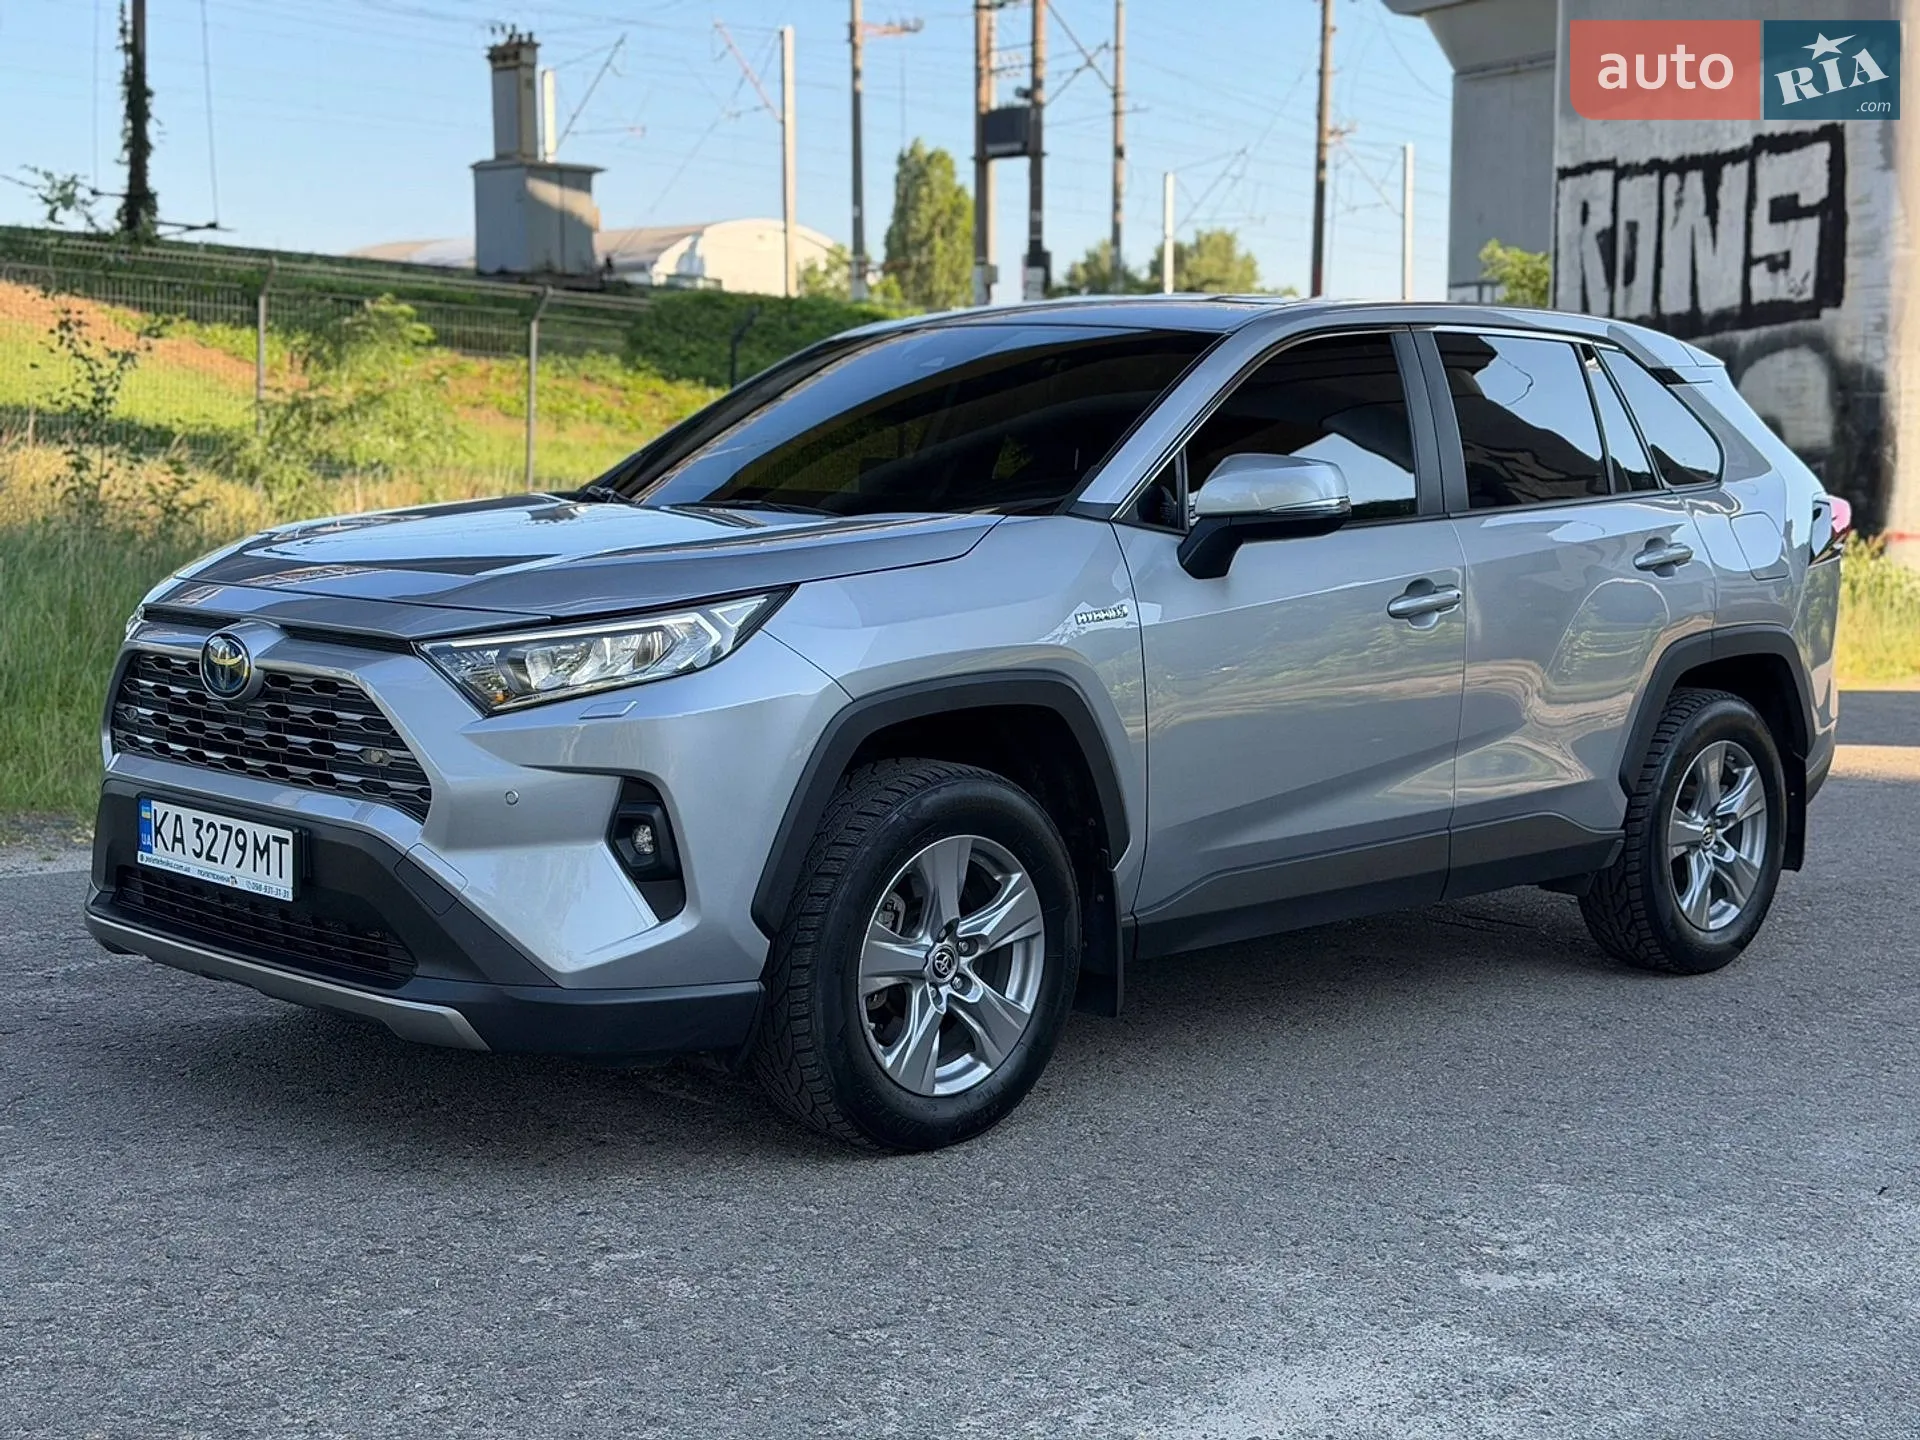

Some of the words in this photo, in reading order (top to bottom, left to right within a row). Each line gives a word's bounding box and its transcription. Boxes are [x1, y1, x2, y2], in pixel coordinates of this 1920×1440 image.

[141, 833, 152, 845] UA
[153, 808, 187, 856] KA
[192, 817, 248, 869] 3279
[253, 830, 290, 879] MT
